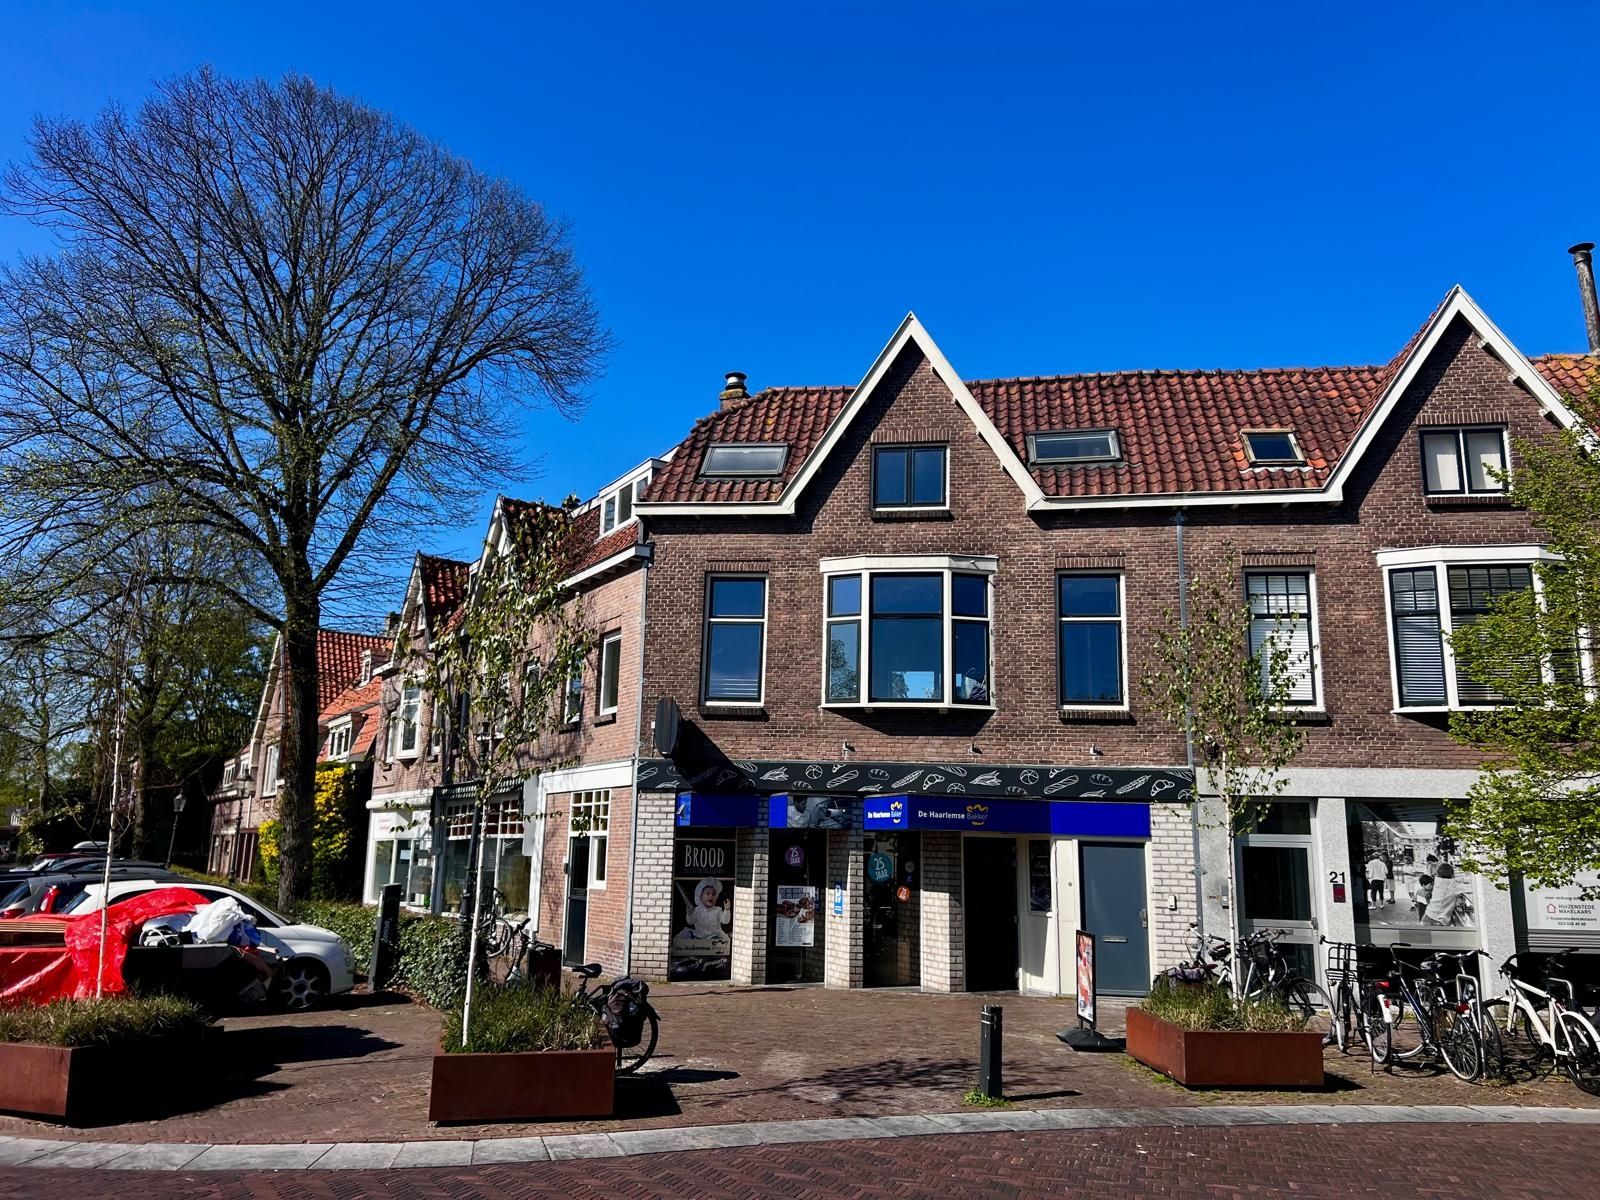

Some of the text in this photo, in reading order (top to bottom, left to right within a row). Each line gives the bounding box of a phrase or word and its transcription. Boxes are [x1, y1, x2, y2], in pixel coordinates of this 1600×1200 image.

[873, 811, 890, 819] Haarlemse
[918, 810, 988, 820] De Haarlemse Bakker
[790, 847, 799, 856] 25
[790, 856, 800, 865] JAAR
[873, 857, 885, 870] 25
[875, 869, 888, 881] JAAR
[1329, 871, 1345, 884] 21
